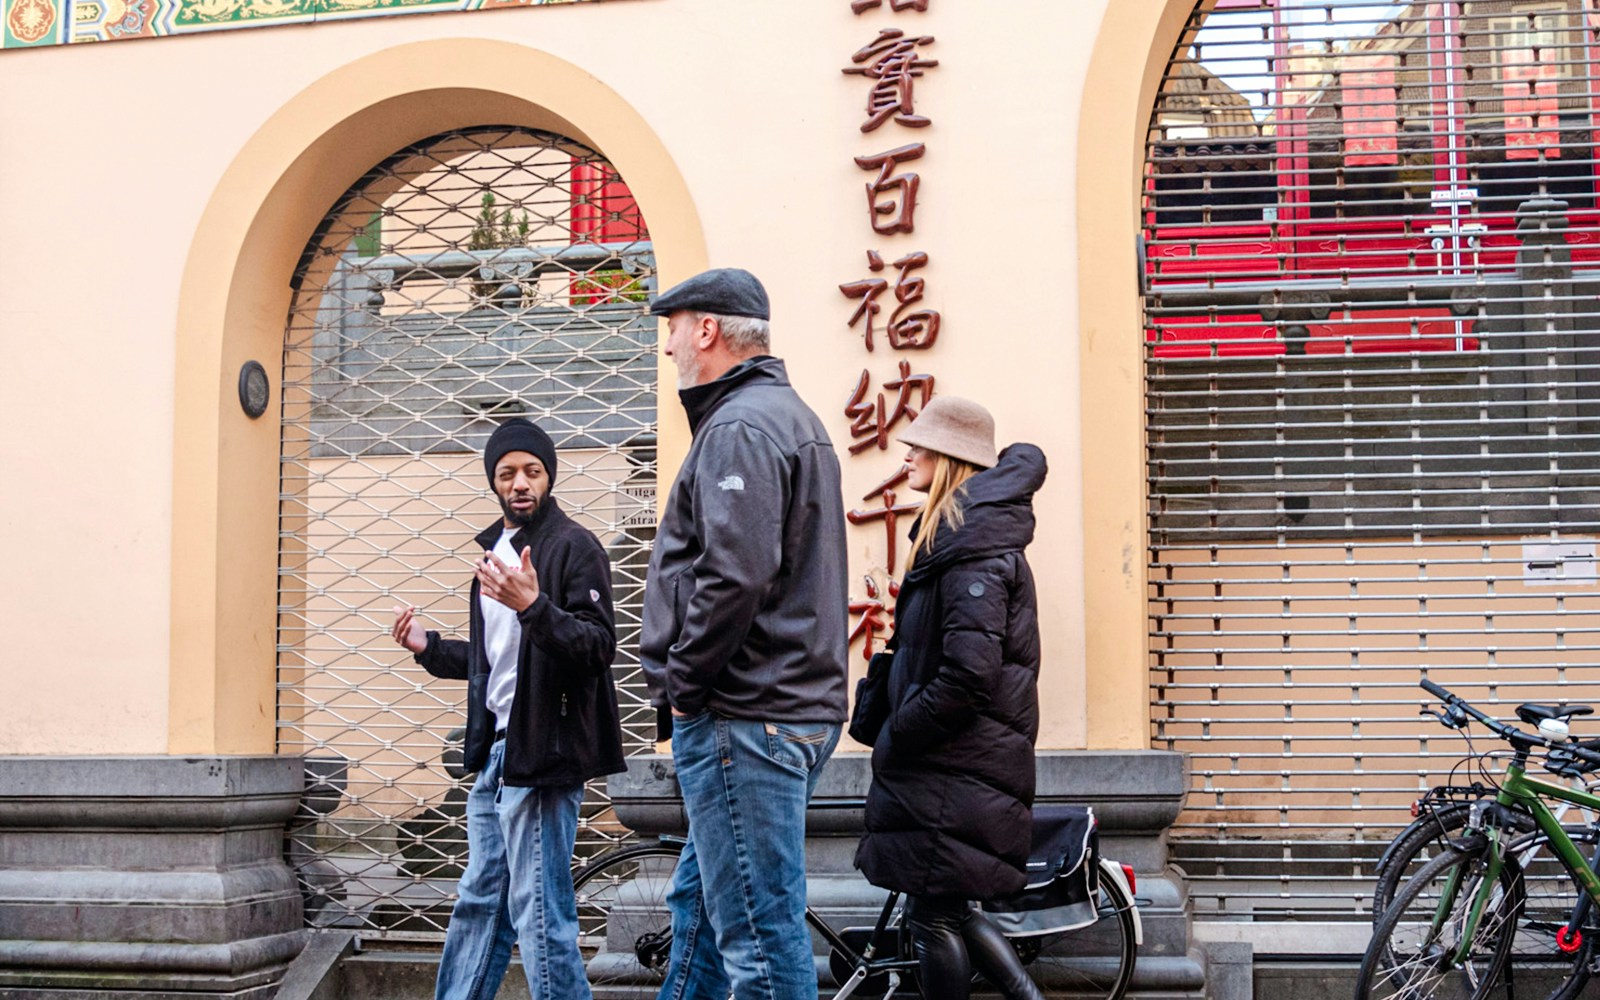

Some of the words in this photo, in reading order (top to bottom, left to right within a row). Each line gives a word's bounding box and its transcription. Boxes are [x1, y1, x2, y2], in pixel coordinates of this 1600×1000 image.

[838, 0, 941, 661] 實百福納千
